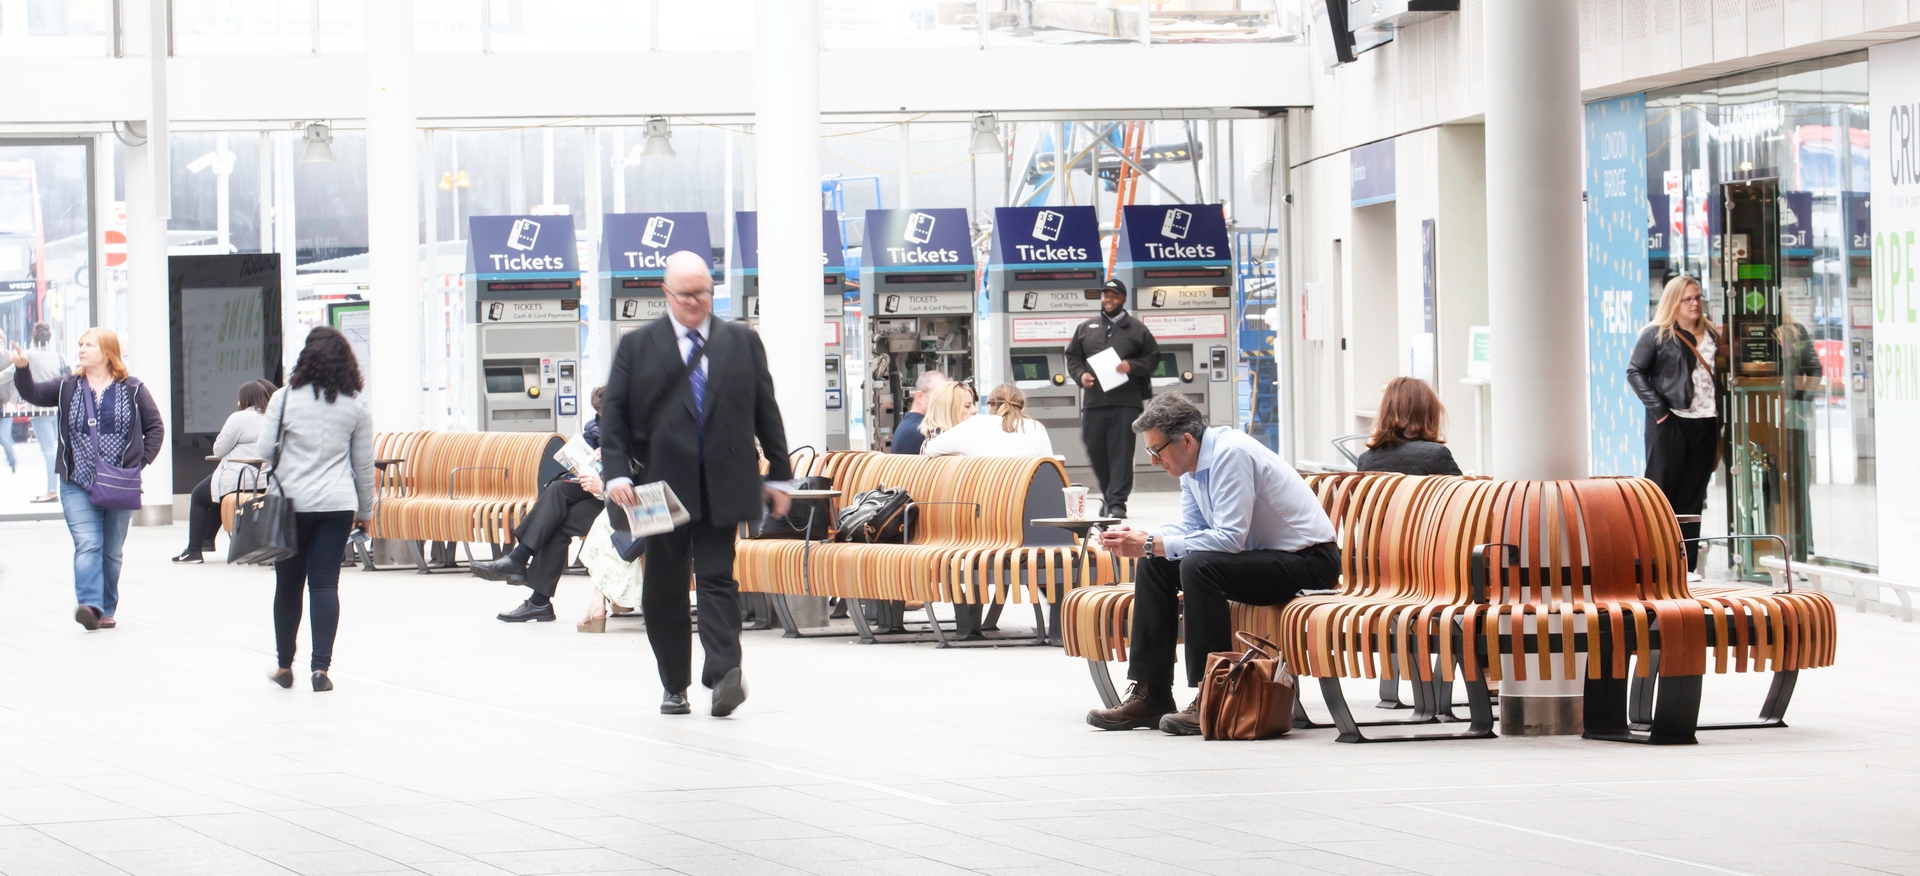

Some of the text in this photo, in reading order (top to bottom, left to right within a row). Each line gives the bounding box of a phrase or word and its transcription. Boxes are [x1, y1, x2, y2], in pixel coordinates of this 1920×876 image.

[1601, 130, 1628, 161] LONDON
[1603, 168, 1627, 198] BRIDGE
[886, 247, 959, 264] Tickets
[1015, 244, 1088, 261] Tickets
[1144, 242, 1216, 259] Tickets
[489, 253, 564, 271] Tickets
[624, 251, 667, 268] Tick
[908, 295, 938, 303] TICKETS
[1050, 292, 1079, 300] TICKETS
[1178, 290, 1207, 298] TICKETS
[513, 303, 543, 311] TICKETS
[647, 300, 667, 308] TICKE
[942, 304, 968, 312] Payments
[1603, 290, 1633, 334] FEAST
[547, 312, 574, 320] Payments
